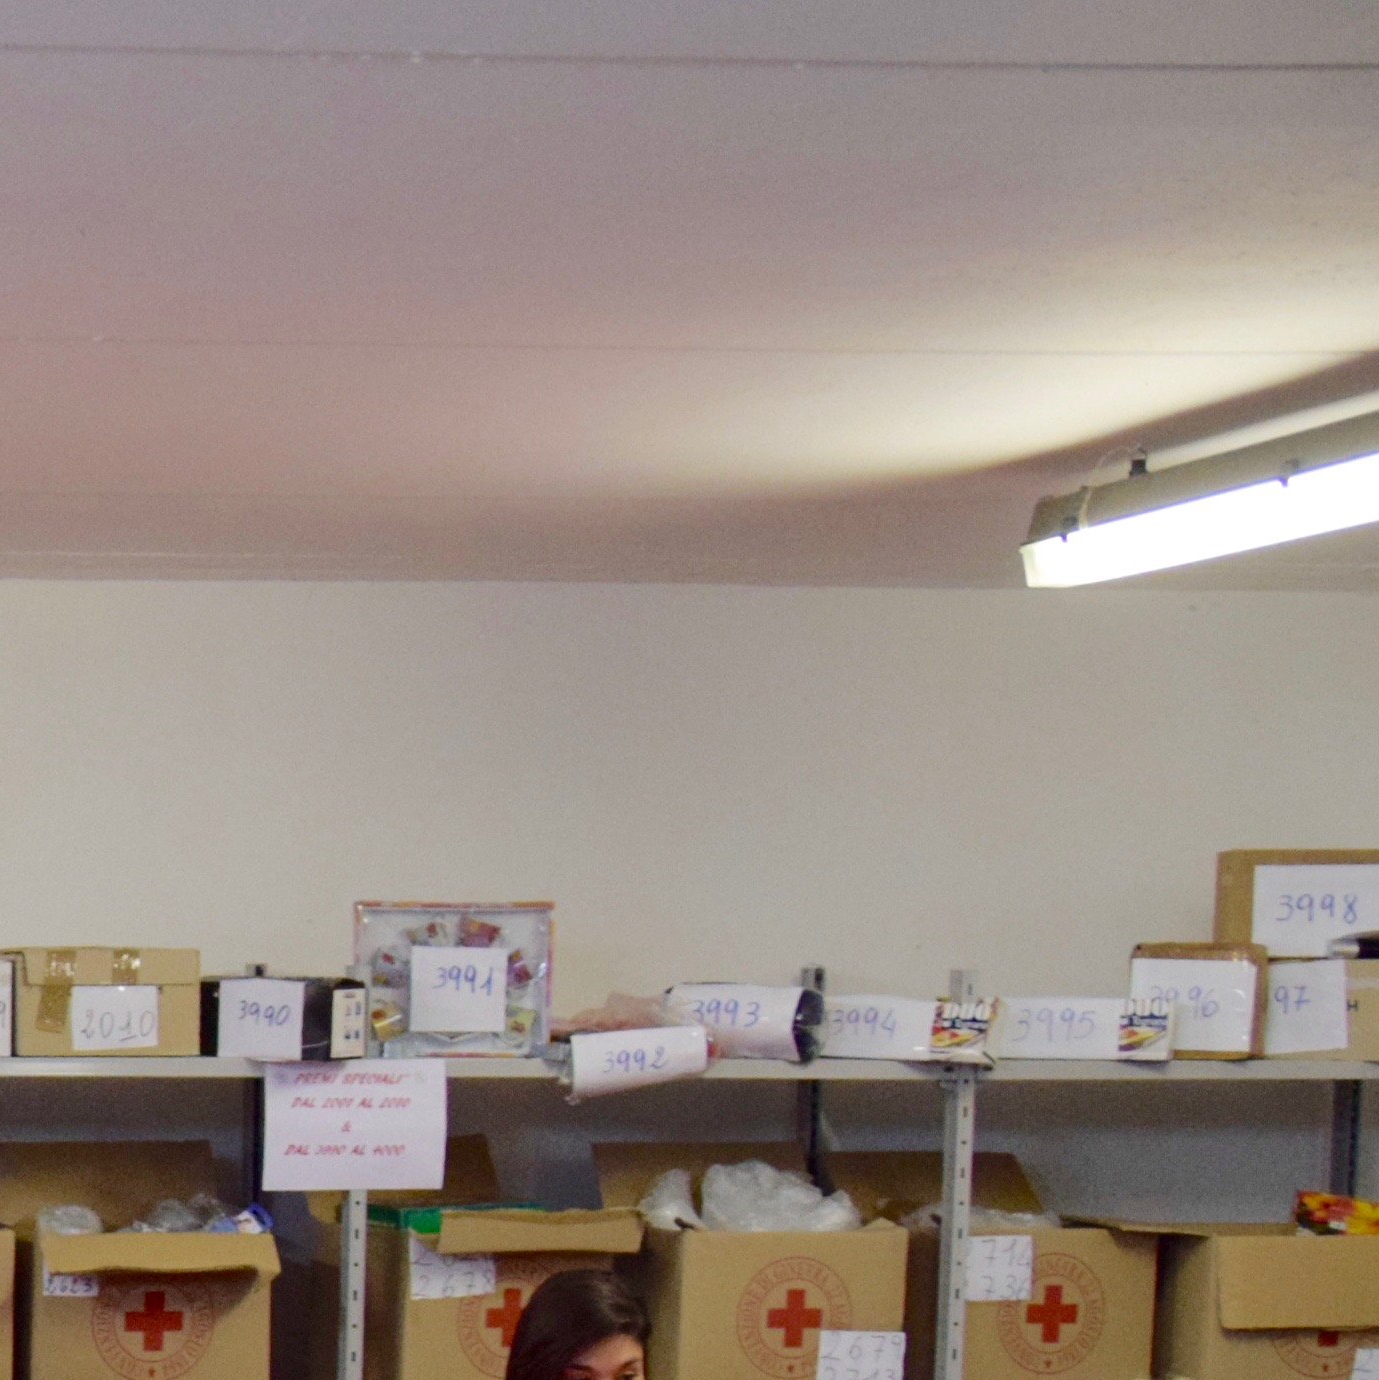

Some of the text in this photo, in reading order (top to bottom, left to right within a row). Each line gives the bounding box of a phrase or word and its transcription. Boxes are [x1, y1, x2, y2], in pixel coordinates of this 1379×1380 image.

[1275, 894, 1358, 925] 3998
[432, 965, 493, 996] 3991
[236, 1000, 292, 1027] 3990
[693, 998, 760, 1027] 3993
[1274, 985, 1311, 1014] 97
[80, 1009, 156, 1041] 2010
[1012, 1008, 1096, 1042] 3995
[602, 1046, 667, 1075] 3992
[291, 1097, 316, 1108] DAL
[358, 1097, 373, 1108] AL
[284, 1144, 310, 1155] DAL
[351, 1144, 366, 1155] AL
